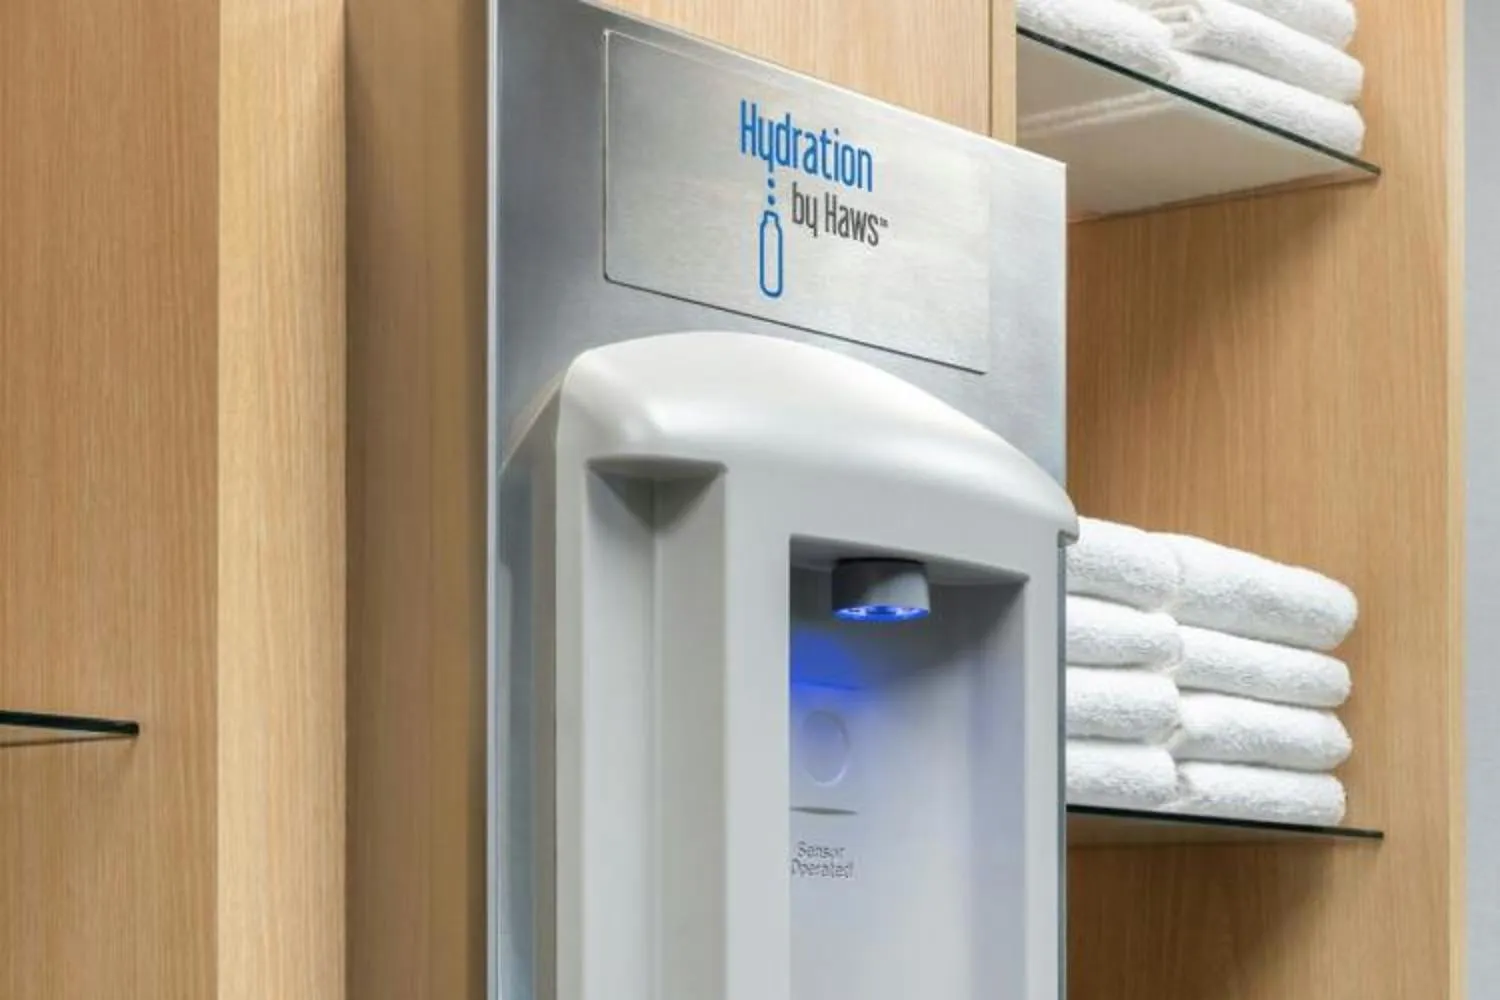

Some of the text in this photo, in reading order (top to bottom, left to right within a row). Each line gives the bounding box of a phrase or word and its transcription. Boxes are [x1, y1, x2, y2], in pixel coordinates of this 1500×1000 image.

[740, 98, 873, 192] Hydration
[791, 181, 818, 239] by
[797, 840, 846, 859] Sensor
